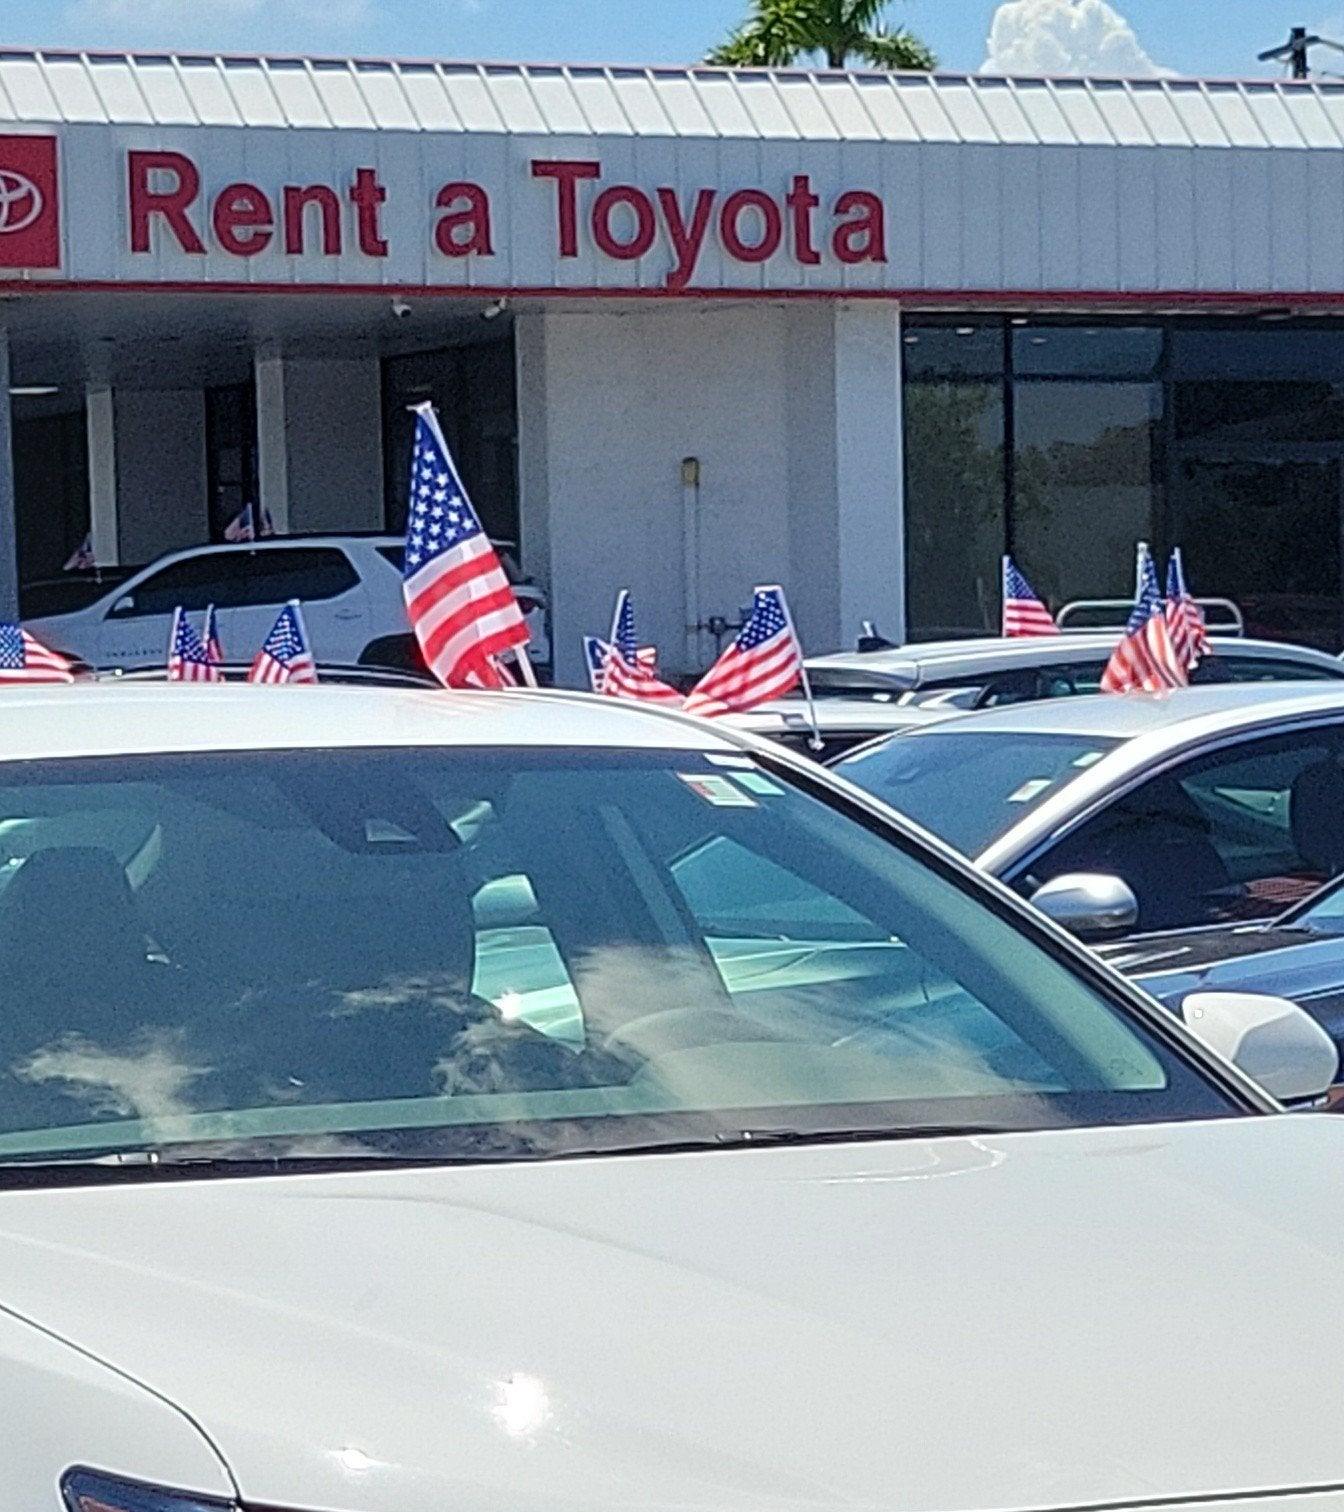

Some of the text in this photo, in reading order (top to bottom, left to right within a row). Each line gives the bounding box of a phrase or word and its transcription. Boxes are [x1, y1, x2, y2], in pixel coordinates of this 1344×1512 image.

[127, 151, 889, 292] Rent a Toyota
